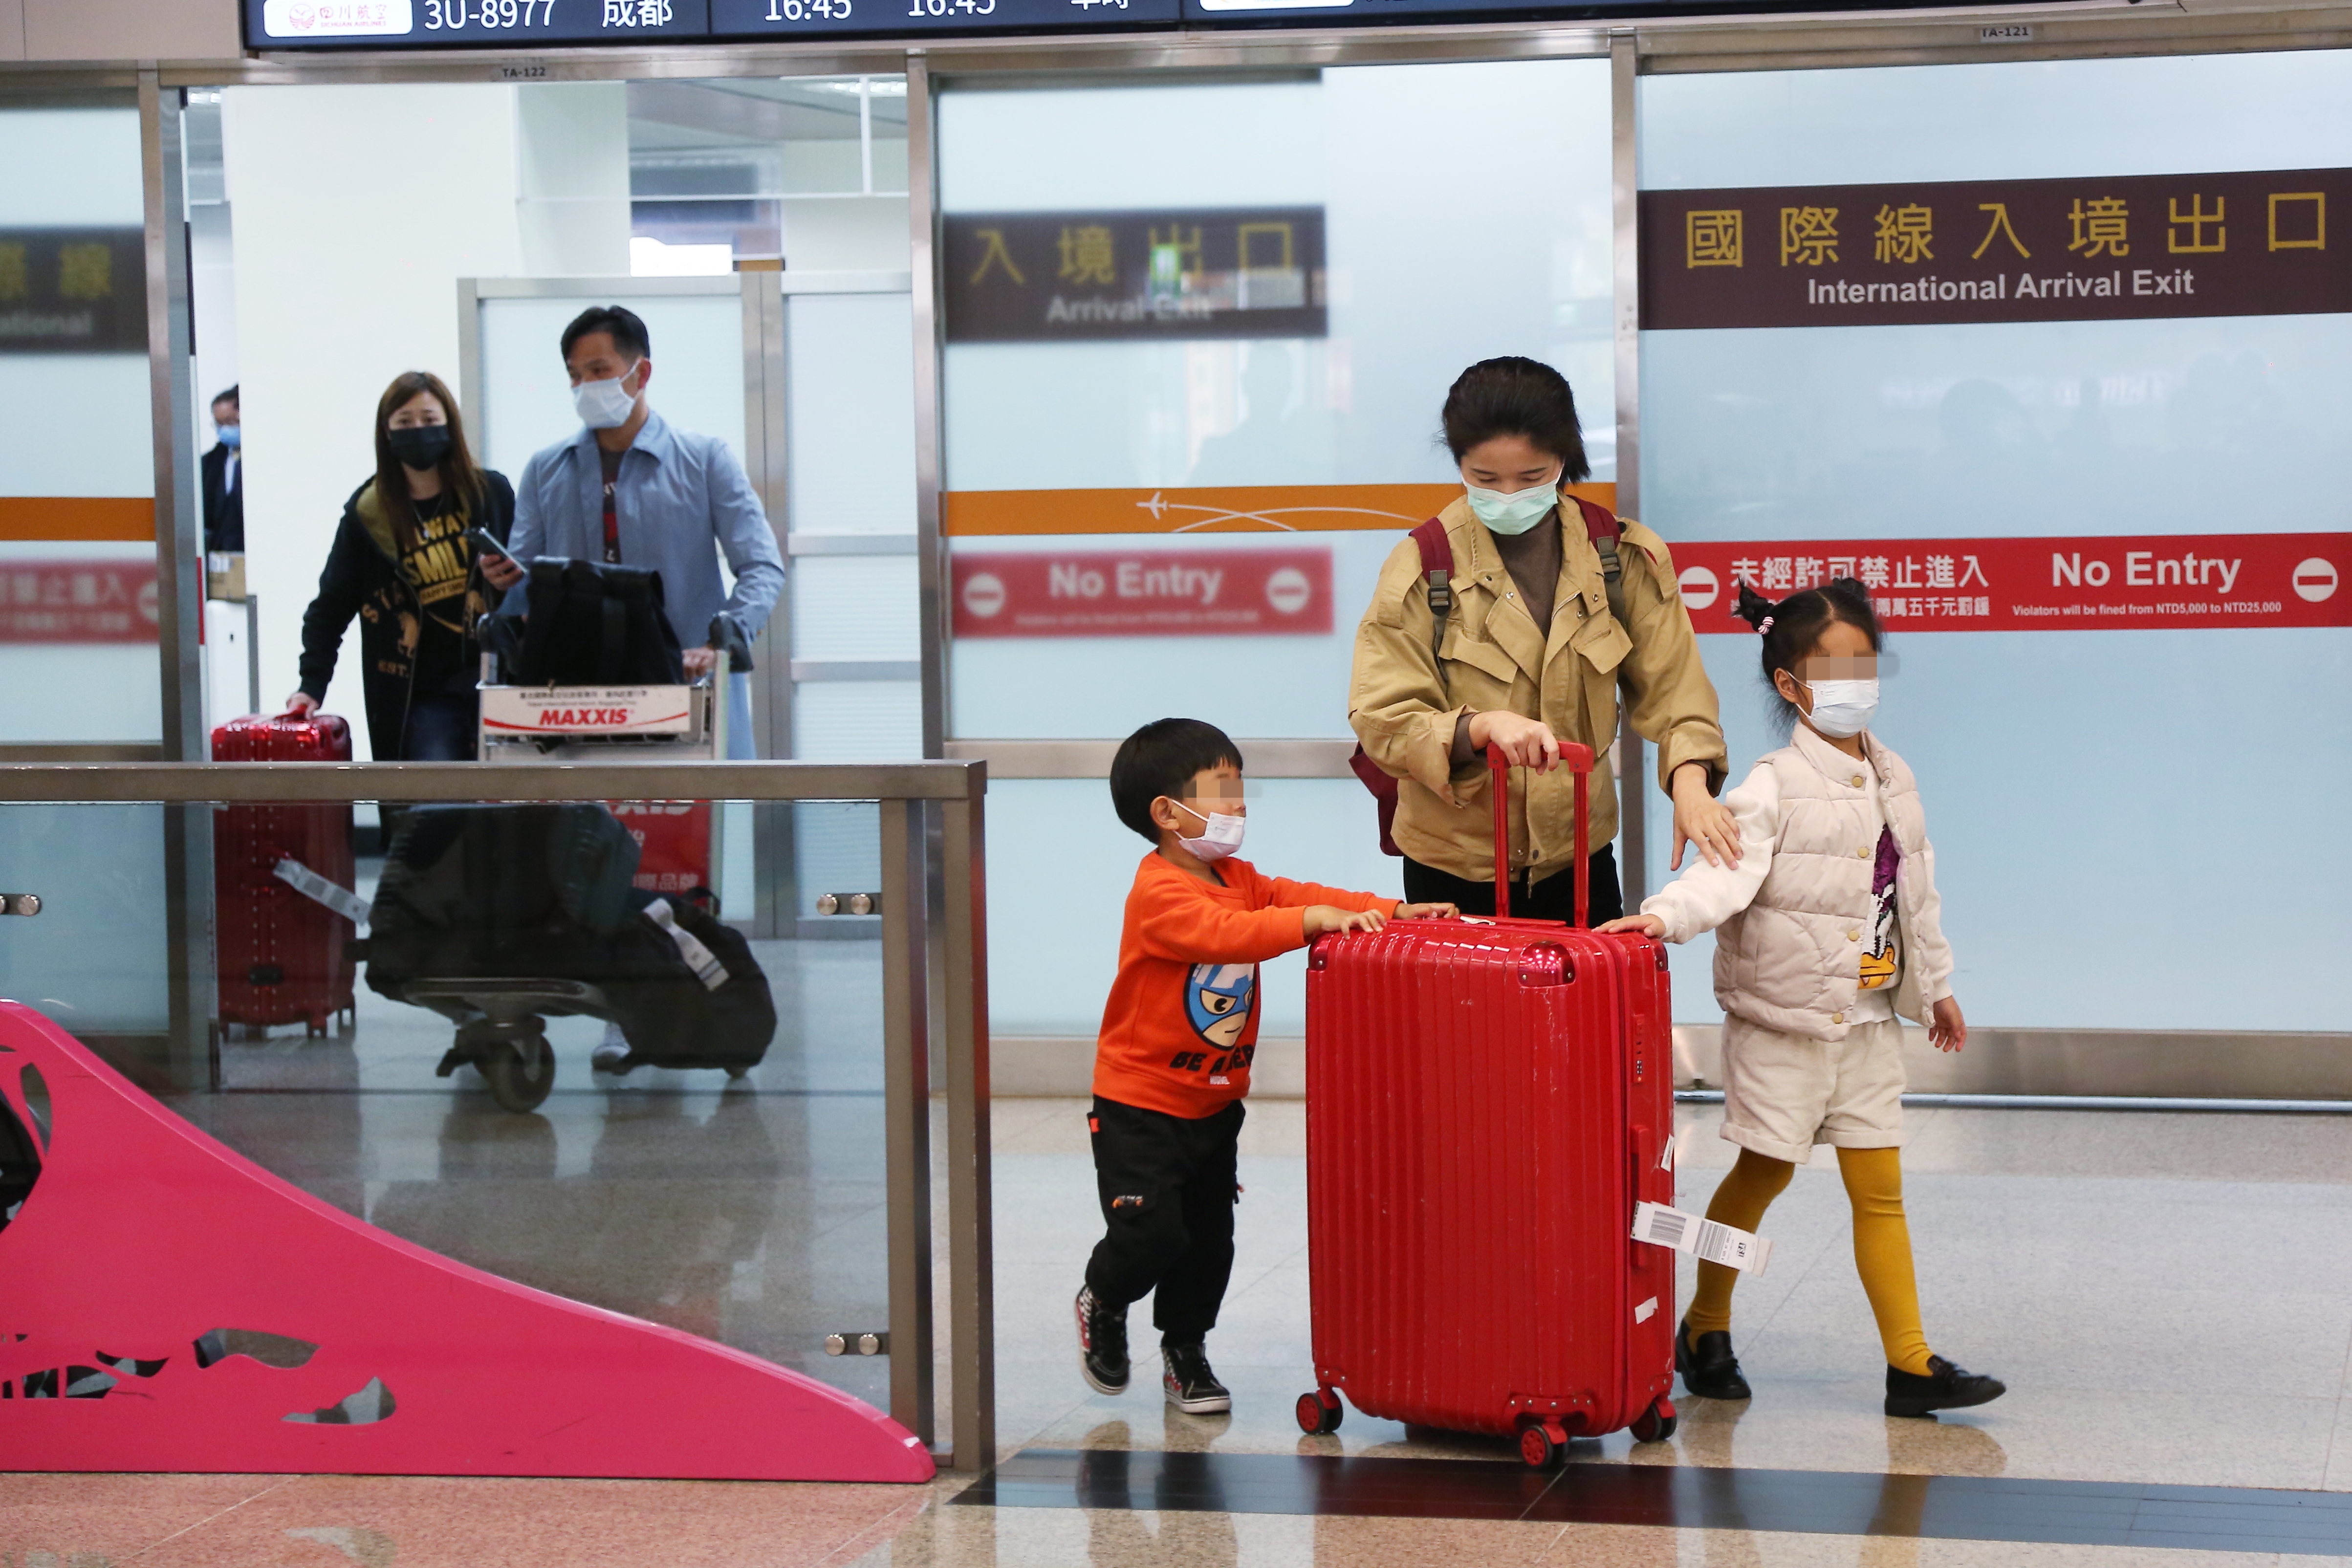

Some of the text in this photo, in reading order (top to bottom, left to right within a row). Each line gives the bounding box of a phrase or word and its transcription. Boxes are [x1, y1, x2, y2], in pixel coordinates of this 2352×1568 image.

[424, 0, 555, 30] 3U-8977
[602, 0, 673, 27] 成都
[765, 0, 852, 21] 16:45
[502, 66, 546, 77] TA-122
[1686, 192, 2325, 269] 國際線入境出口
[970, 223, 1292, 285] 入境出口
[1809, 268, 2194, 304] International Arrival Exit
[1047, 295, 1144, 323] Arrival
[1049, 562, 1223, 606] No Entry
[1730, 554, 1989, 590] 未經許可禁止進入
[2053, 551, 2242, 594] No Entry
[2012, 601, 2281, 616] Violators will be fined from NTD5,000 to NTD25,000
[540, 708, 627, 726] MAXXIS
[1169, 1051, 1207, 1071] BE
